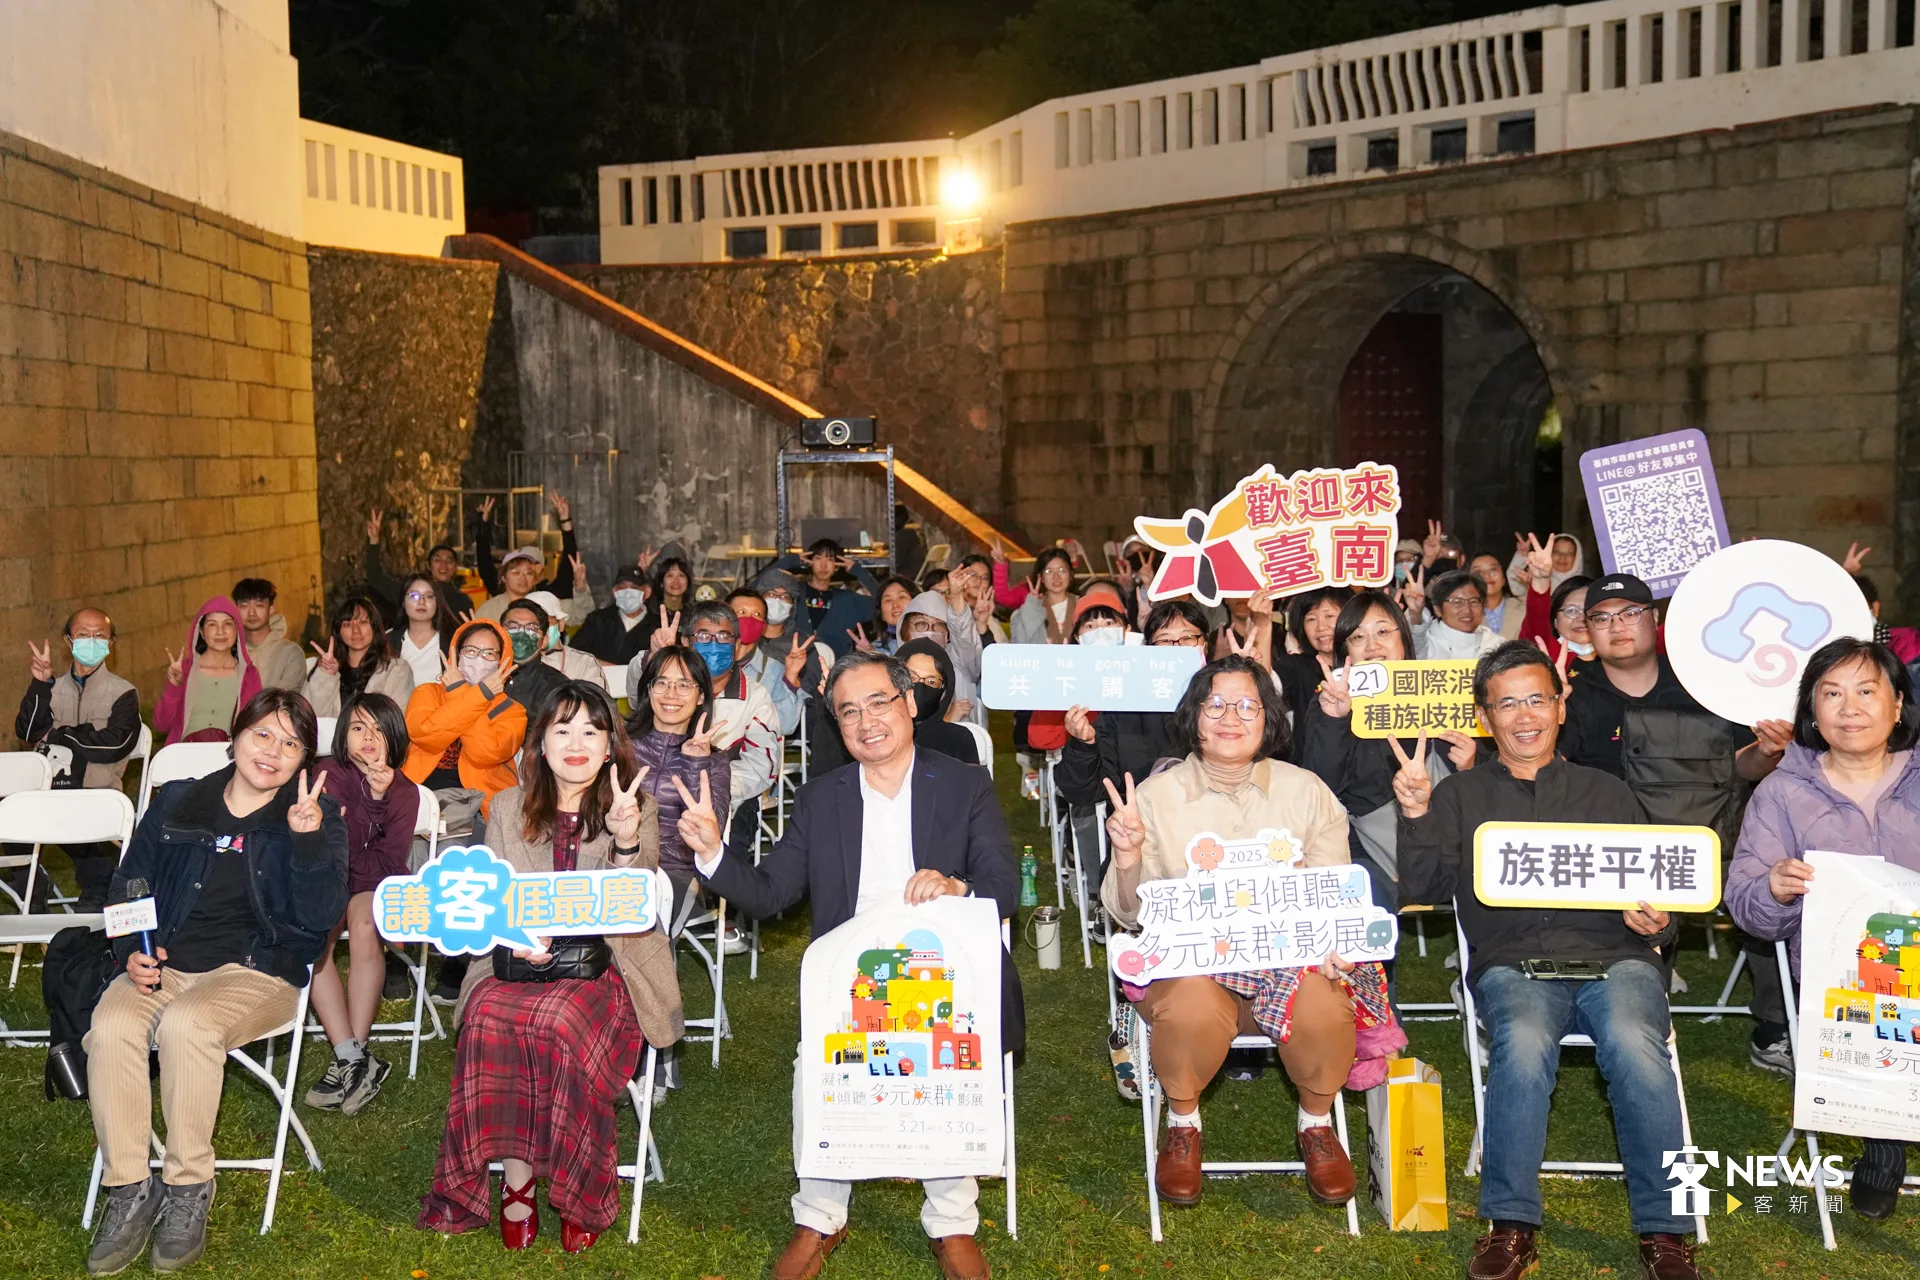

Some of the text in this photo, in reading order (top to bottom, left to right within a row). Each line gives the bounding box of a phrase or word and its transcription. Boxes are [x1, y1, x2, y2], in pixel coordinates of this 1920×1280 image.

[1596, 452, 1698, 482] LINE@ 好友募集中
[1244, 470, 1393, 527] 歡迎來
[1258, 525, 1388, 592] 臺南
[1000, 655, 1040, 671] kiung
[1057, 656, 1074, 669] ha
[1363, 702, 1478, 731] 種族歧視
[1229, 849, 1263, 864] 2025
[1498, 841, 1698, 891] 族群平權
[1141, 869, 1342, 926] 凝視與傾聽
[1136, 916, 1373, 972] 多元族群影展
[1818, 1026, 1853, 1047] 凝視
[1818, 1047, 1872, 1068] 與傾聽
[821, 1072, 852, 1087] 凝視
[822, 1082, 985, 1107] 與傾聽 多元族群 影展
